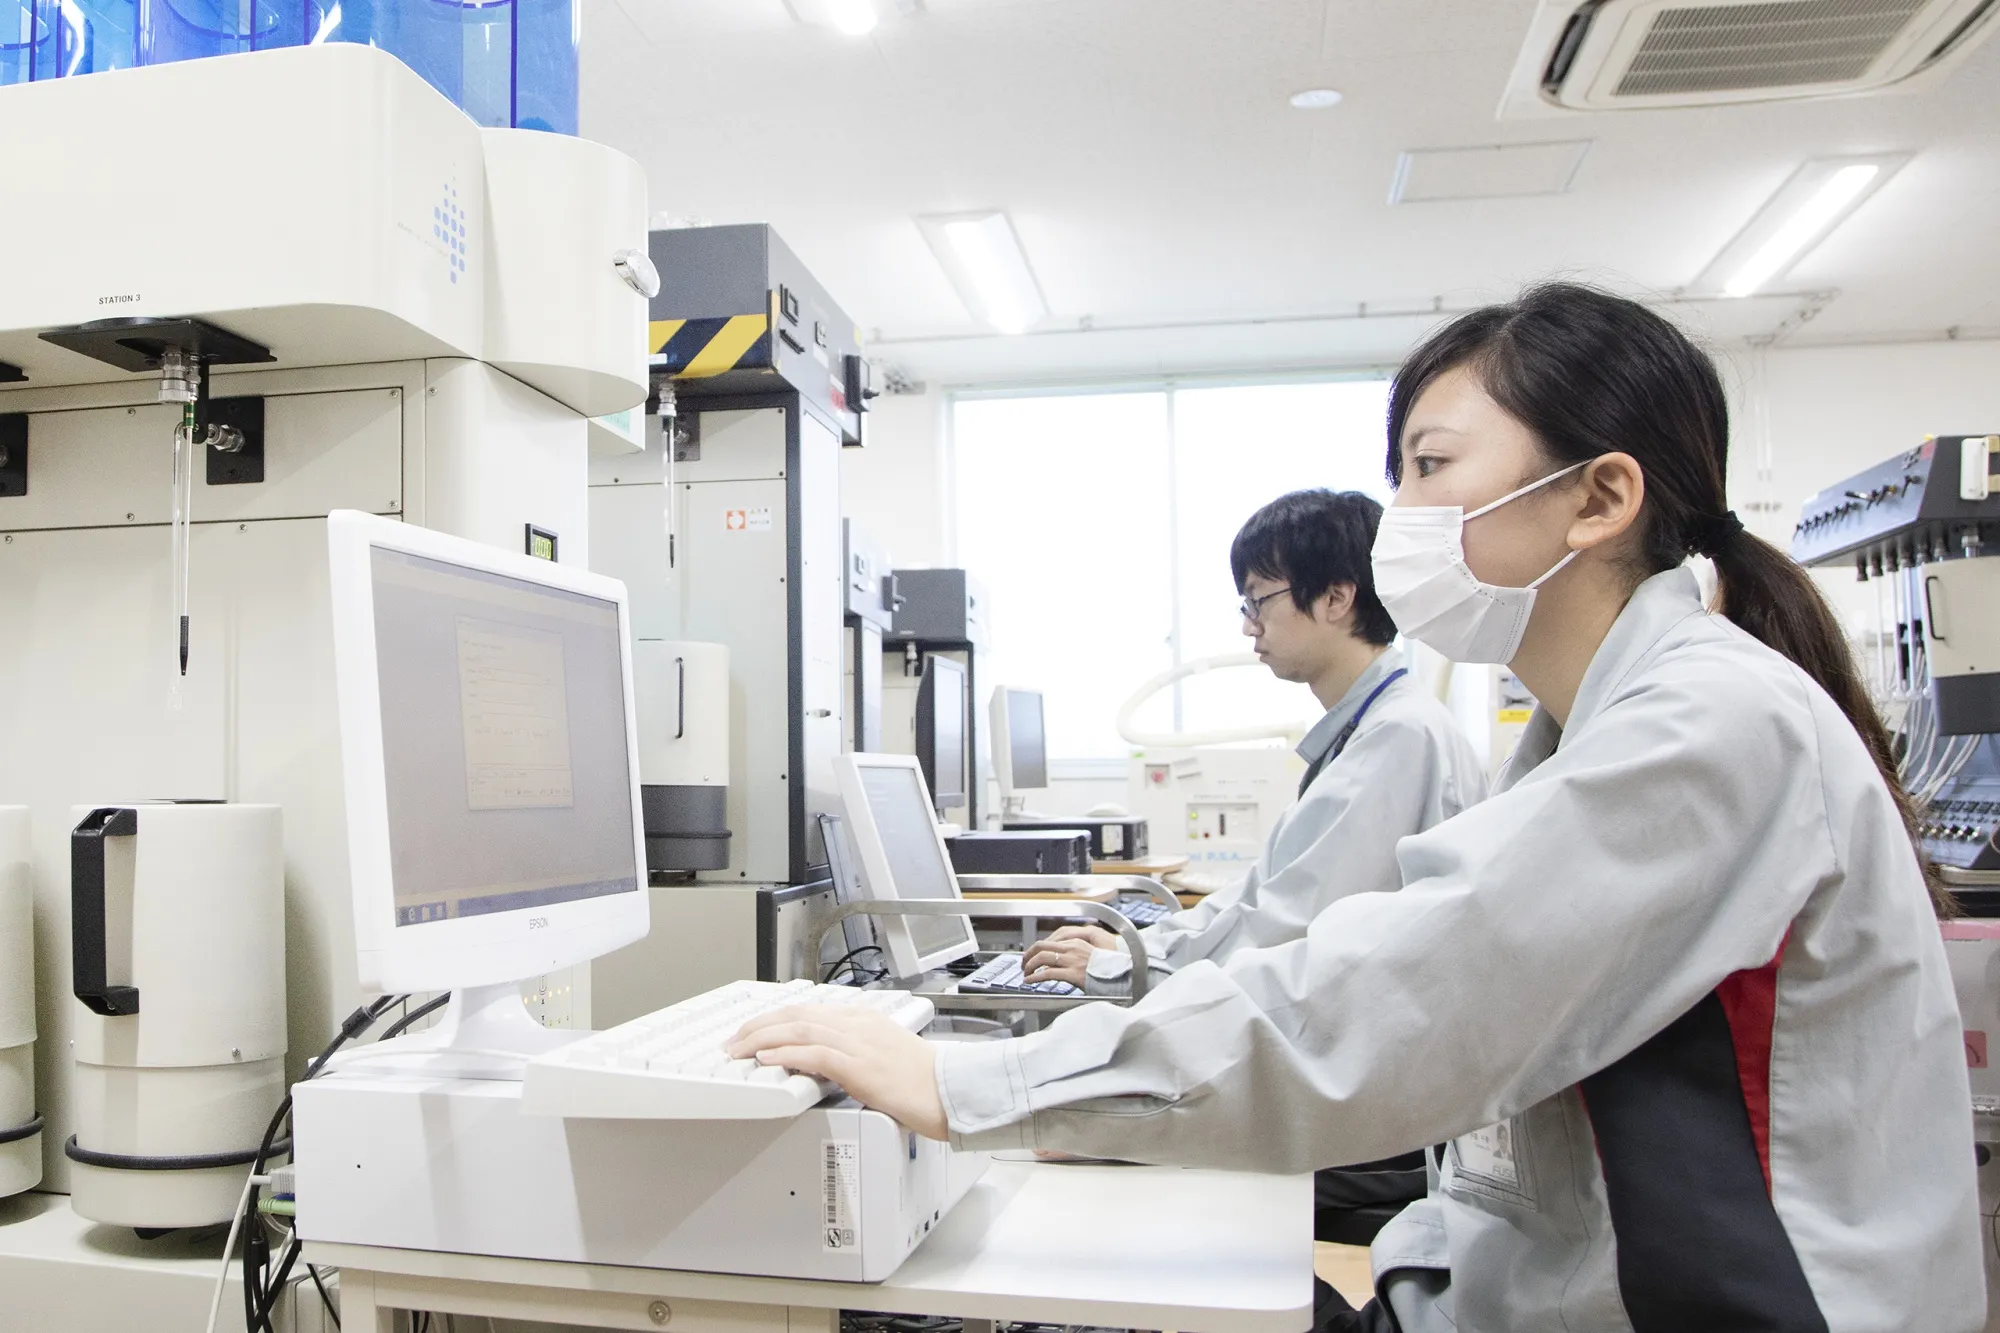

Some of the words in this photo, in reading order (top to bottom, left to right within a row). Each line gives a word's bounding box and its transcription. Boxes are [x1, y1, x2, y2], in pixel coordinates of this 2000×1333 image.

[98, 295, 133, 305] STATION
[135, 293, 141, 302] 3
[529, 917, 548, 930] EPSON
